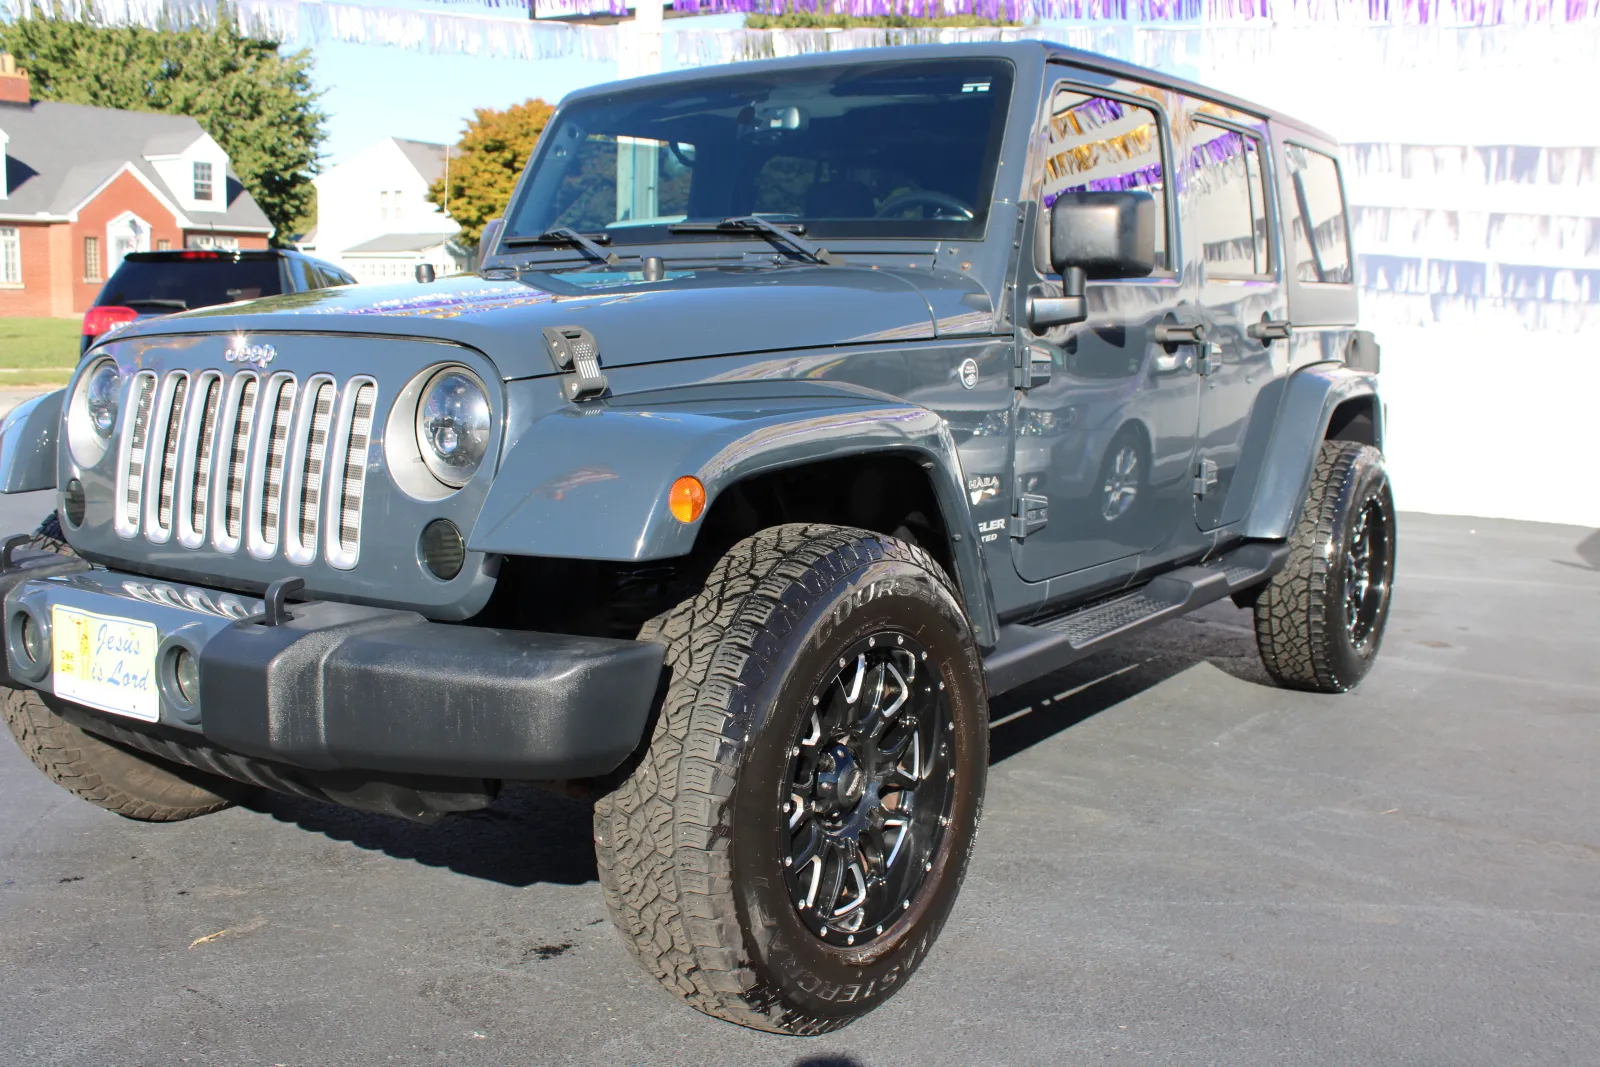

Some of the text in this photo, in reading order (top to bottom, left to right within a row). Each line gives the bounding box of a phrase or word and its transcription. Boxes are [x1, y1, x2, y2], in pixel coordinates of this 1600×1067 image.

[225, 343, 277, 368] Jeep
[96, 623, 140, 656] Jesus
[91, 659, 150, 691] is Lord
